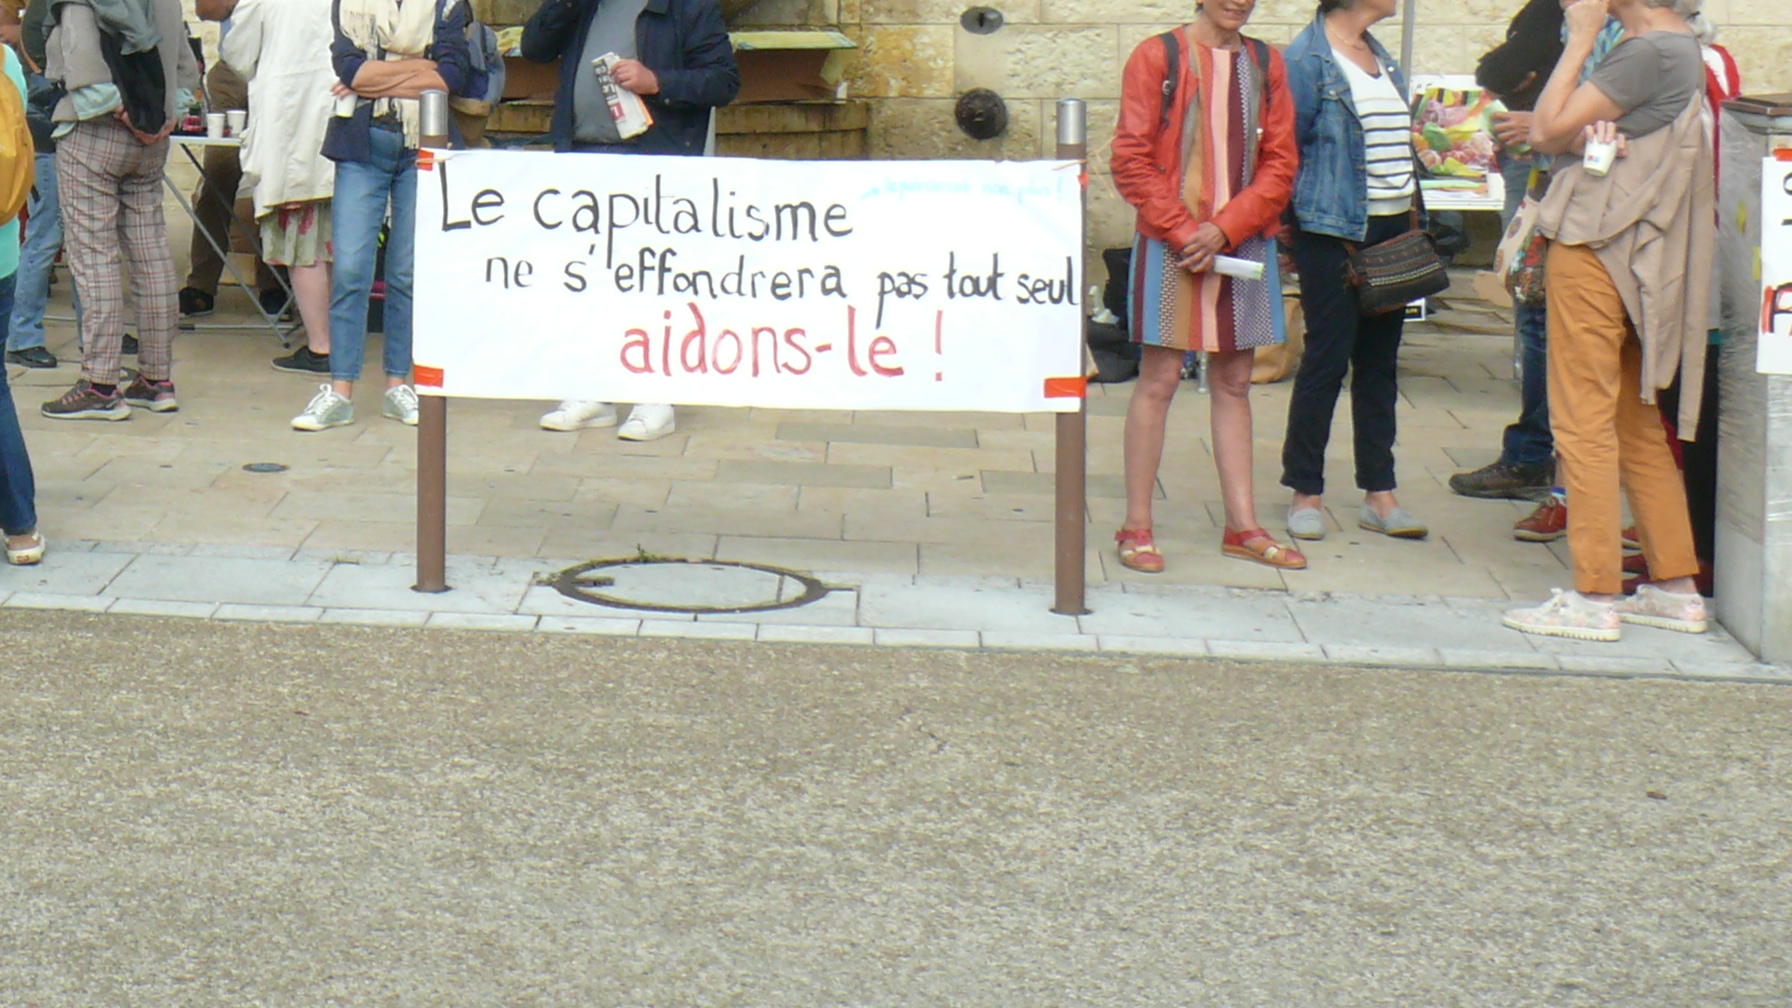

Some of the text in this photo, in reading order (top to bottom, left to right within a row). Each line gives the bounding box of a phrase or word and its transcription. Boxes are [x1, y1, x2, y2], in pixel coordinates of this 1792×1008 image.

[440, 160, 856, 270] Le capitalisme
[484, 243, 1080, 329] ne s'effondrera pas tout seul
[619, 301, 945, 382] aidons-le !
